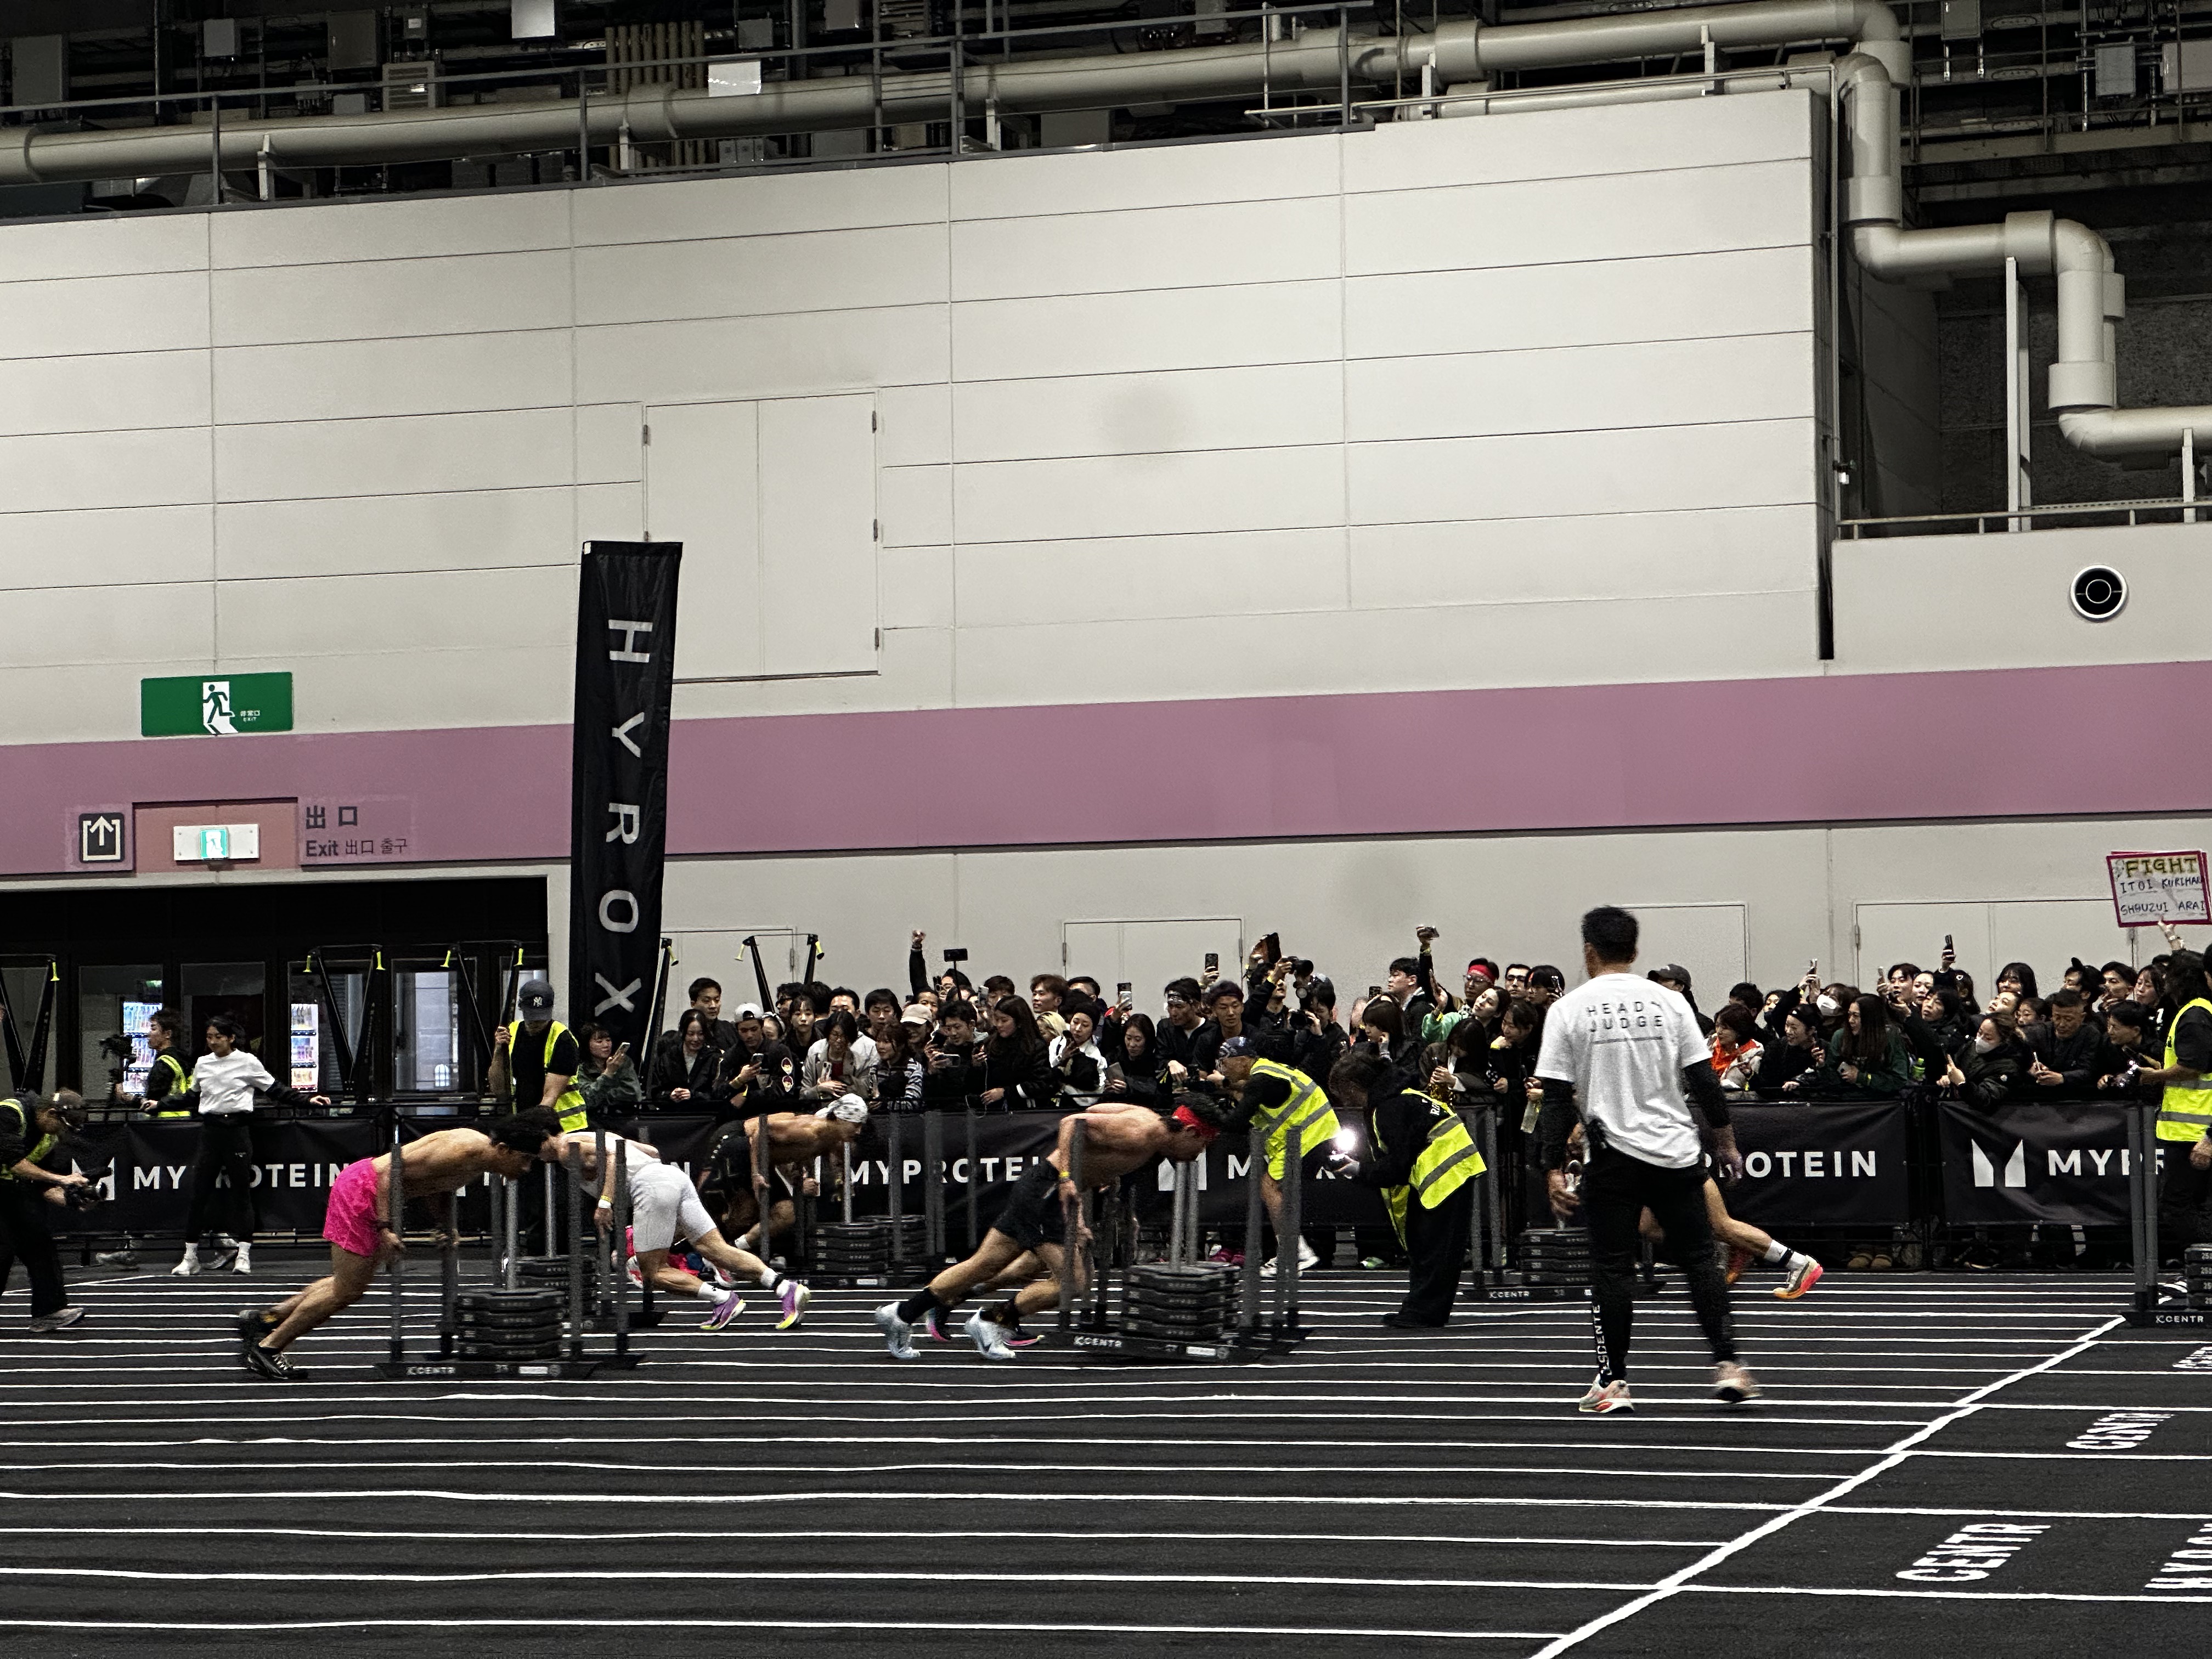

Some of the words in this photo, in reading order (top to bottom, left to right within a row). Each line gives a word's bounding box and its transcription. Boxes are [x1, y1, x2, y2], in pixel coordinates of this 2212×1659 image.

[306, 805, 357, 829] 出口
[595, 619, 653, 1017] HYROX
[306, 839, 338, 856] Exit
[346, 839, 374, 854] 出口
[2125, 857, 2197, 878] FIGHT
[2120, 879, 2153, 894] ITOI
[2179, 900, 2205, 911] ARAI
[1589, 1015, 1663, 1032] JUDGE
[1896, 1523, 2051, 1581] CENTR
